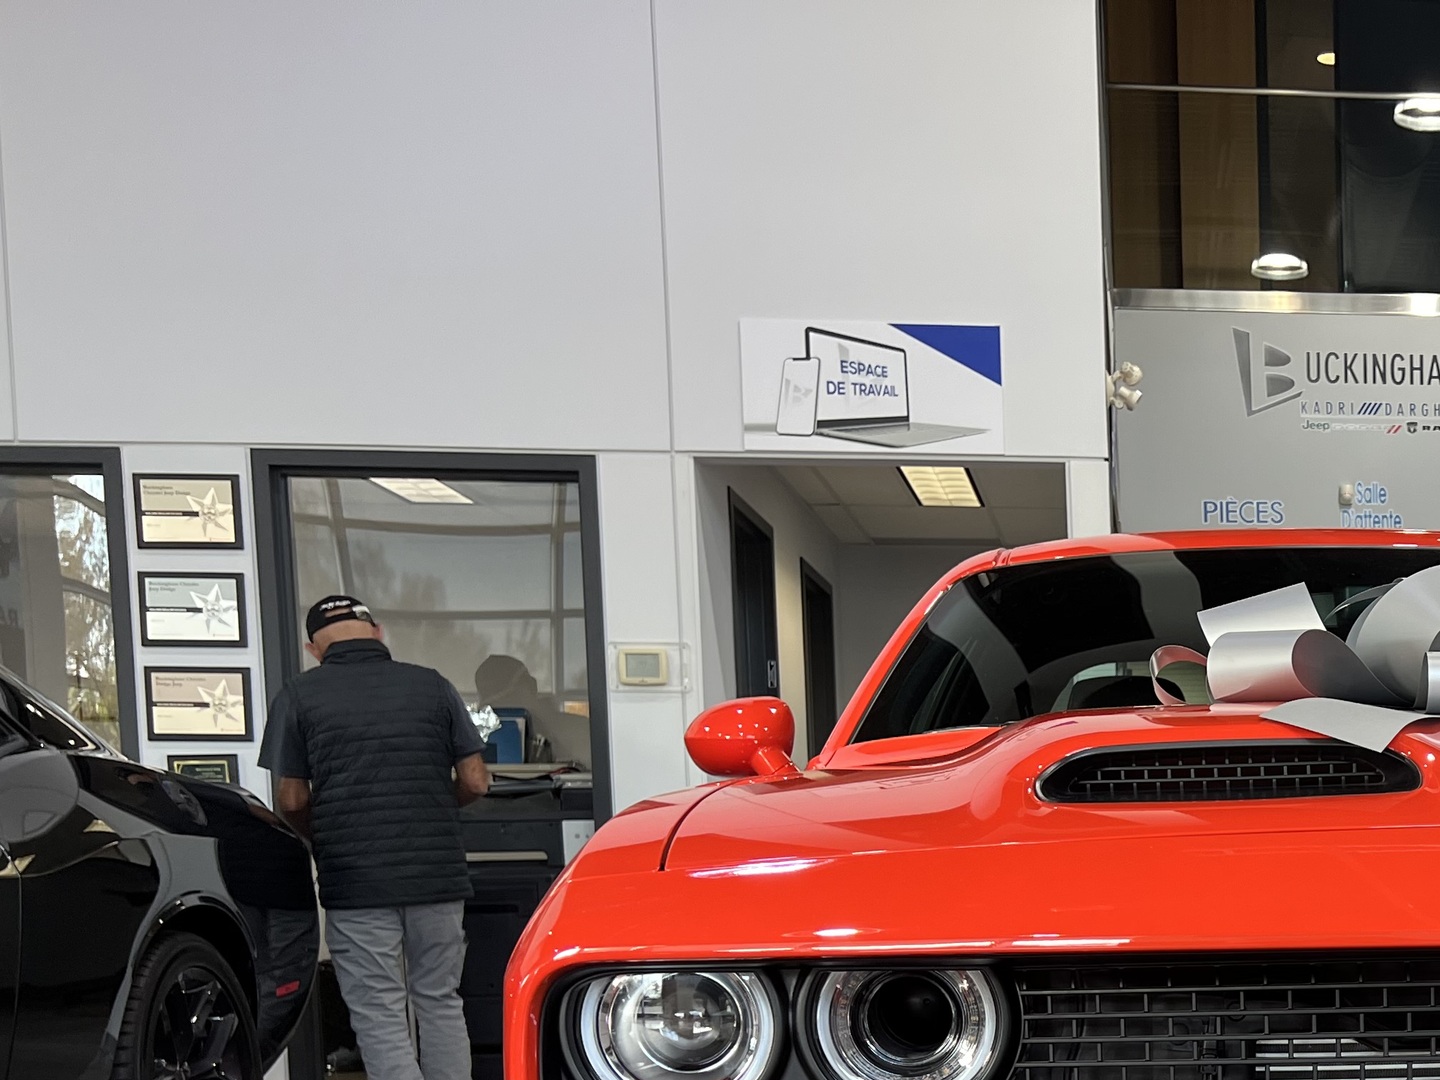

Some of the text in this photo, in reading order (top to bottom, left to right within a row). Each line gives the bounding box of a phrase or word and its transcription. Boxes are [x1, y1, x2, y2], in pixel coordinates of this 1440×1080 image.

[840, 360, 888, 378] ESPACE
[826, 381, 898, 397] DE TRAVAIL
[1302, 420, 1330, 431] Jeep
[1356, 482, 1387, 503] Salle
[1203, 497, 1283, 523] PIÈCES
